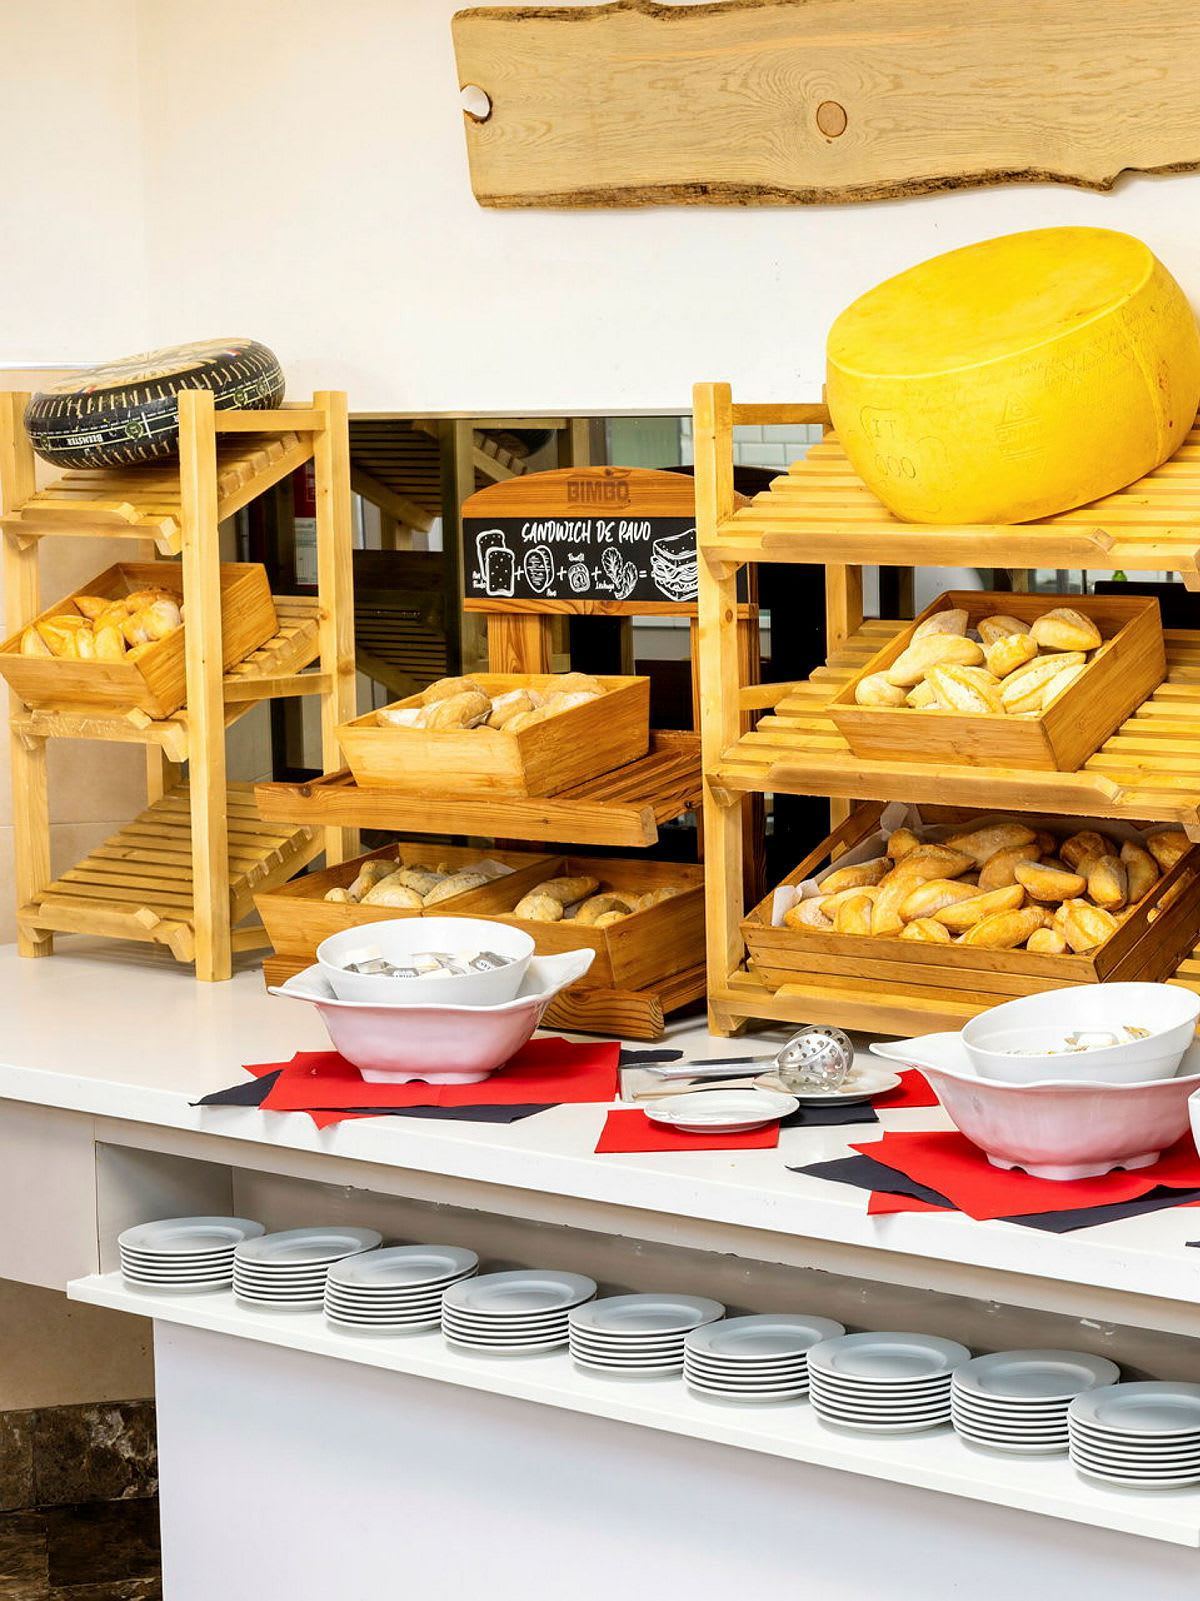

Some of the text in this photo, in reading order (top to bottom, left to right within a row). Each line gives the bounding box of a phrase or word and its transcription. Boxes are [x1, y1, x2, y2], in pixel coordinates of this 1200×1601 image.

[567, 481, 629, 503] BIMBO
[521, 520, 591, 543] SANDWICH
[596, 520, 616, 543] DE
